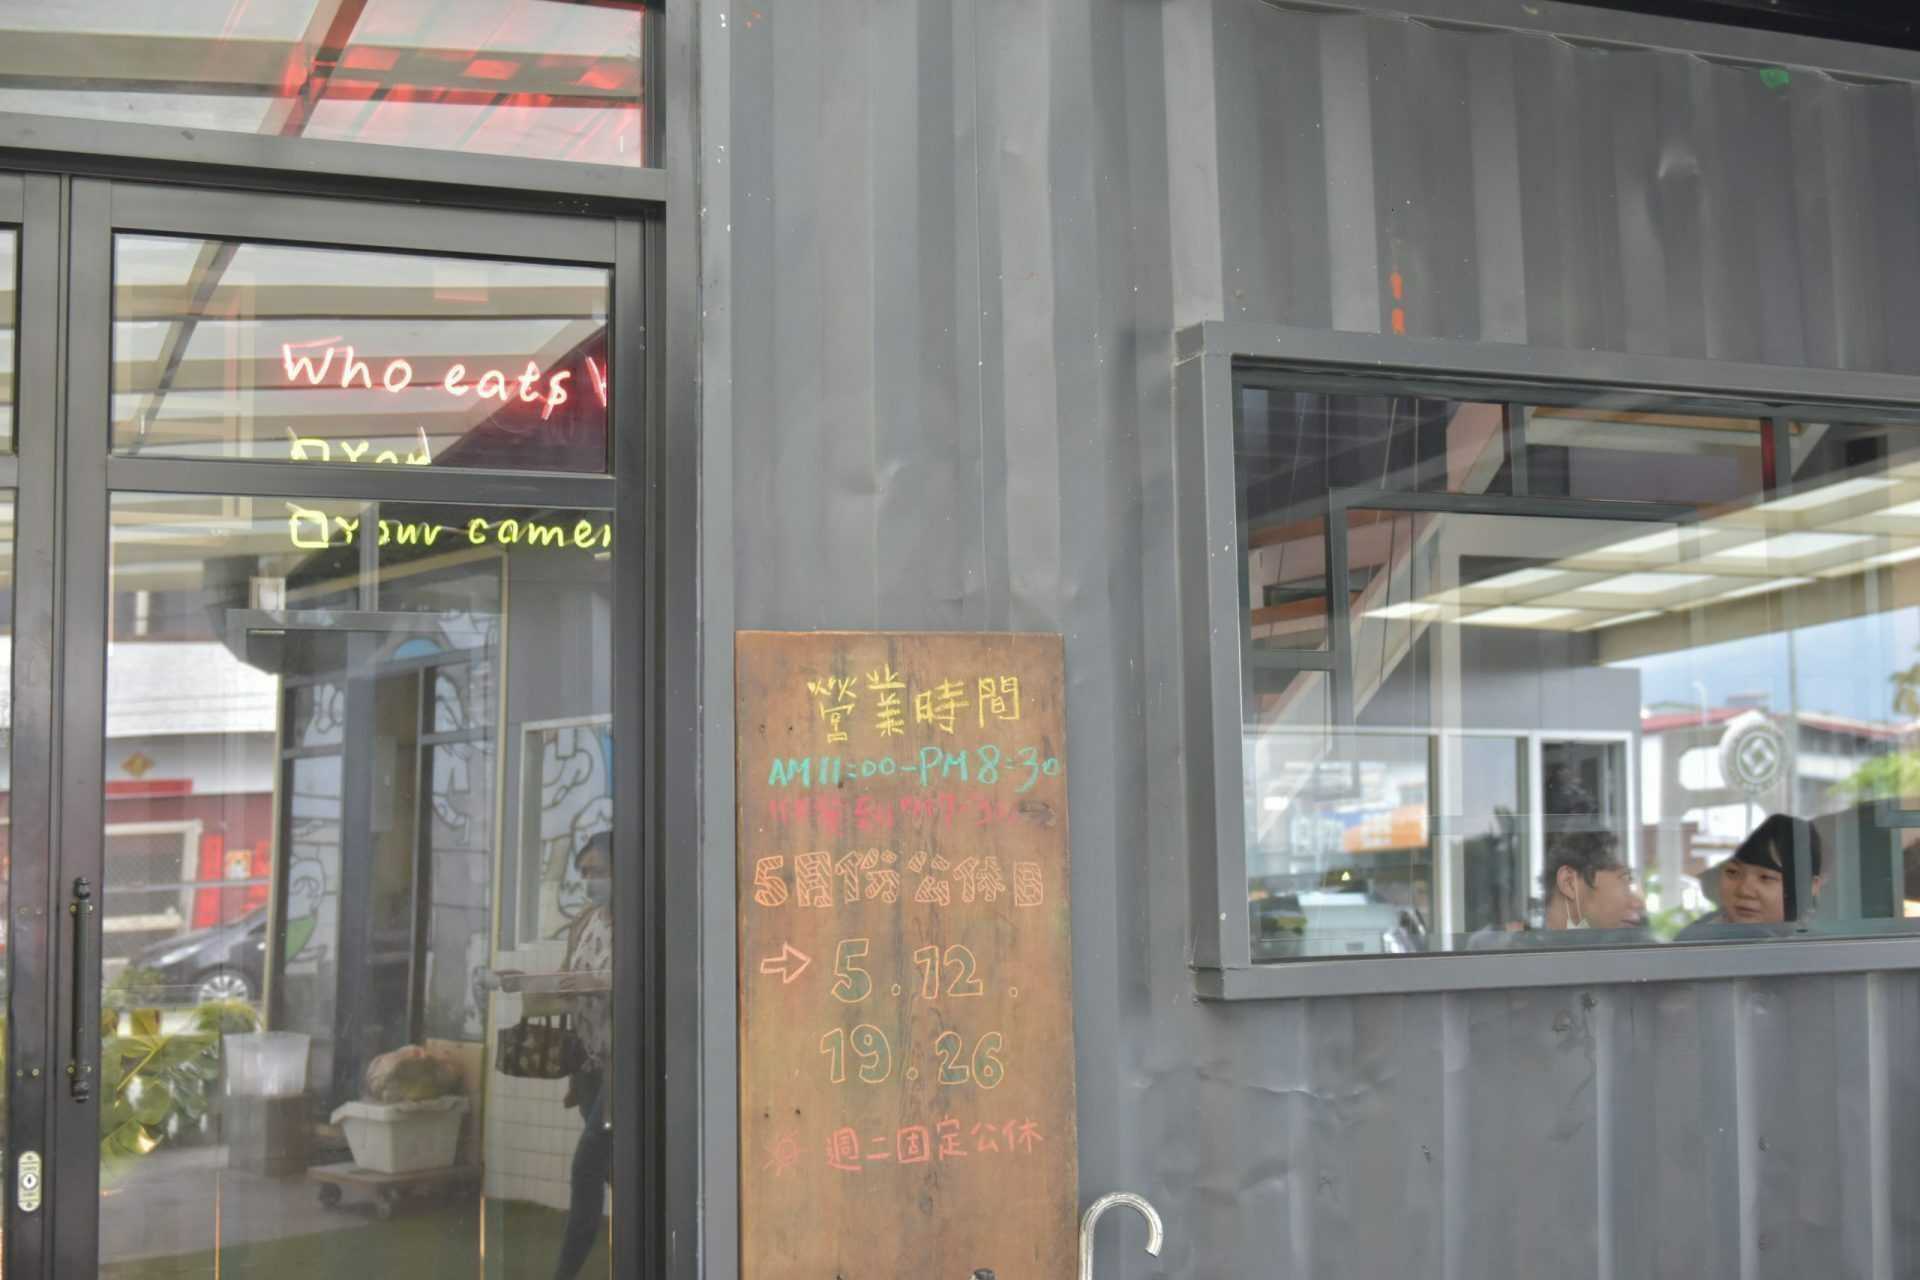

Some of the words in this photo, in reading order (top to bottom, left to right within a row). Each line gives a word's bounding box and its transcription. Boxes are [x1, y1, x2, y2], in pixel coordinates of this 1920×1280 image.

[283, 343, 412, 393] Who
[444, 360, 571, 419] eats
[807, 664, 1021, 743] 營業時間
[754, 848, 1044, 908] 5月份公休日
[827, 1115, 1044, 1172] 週二固定公休
